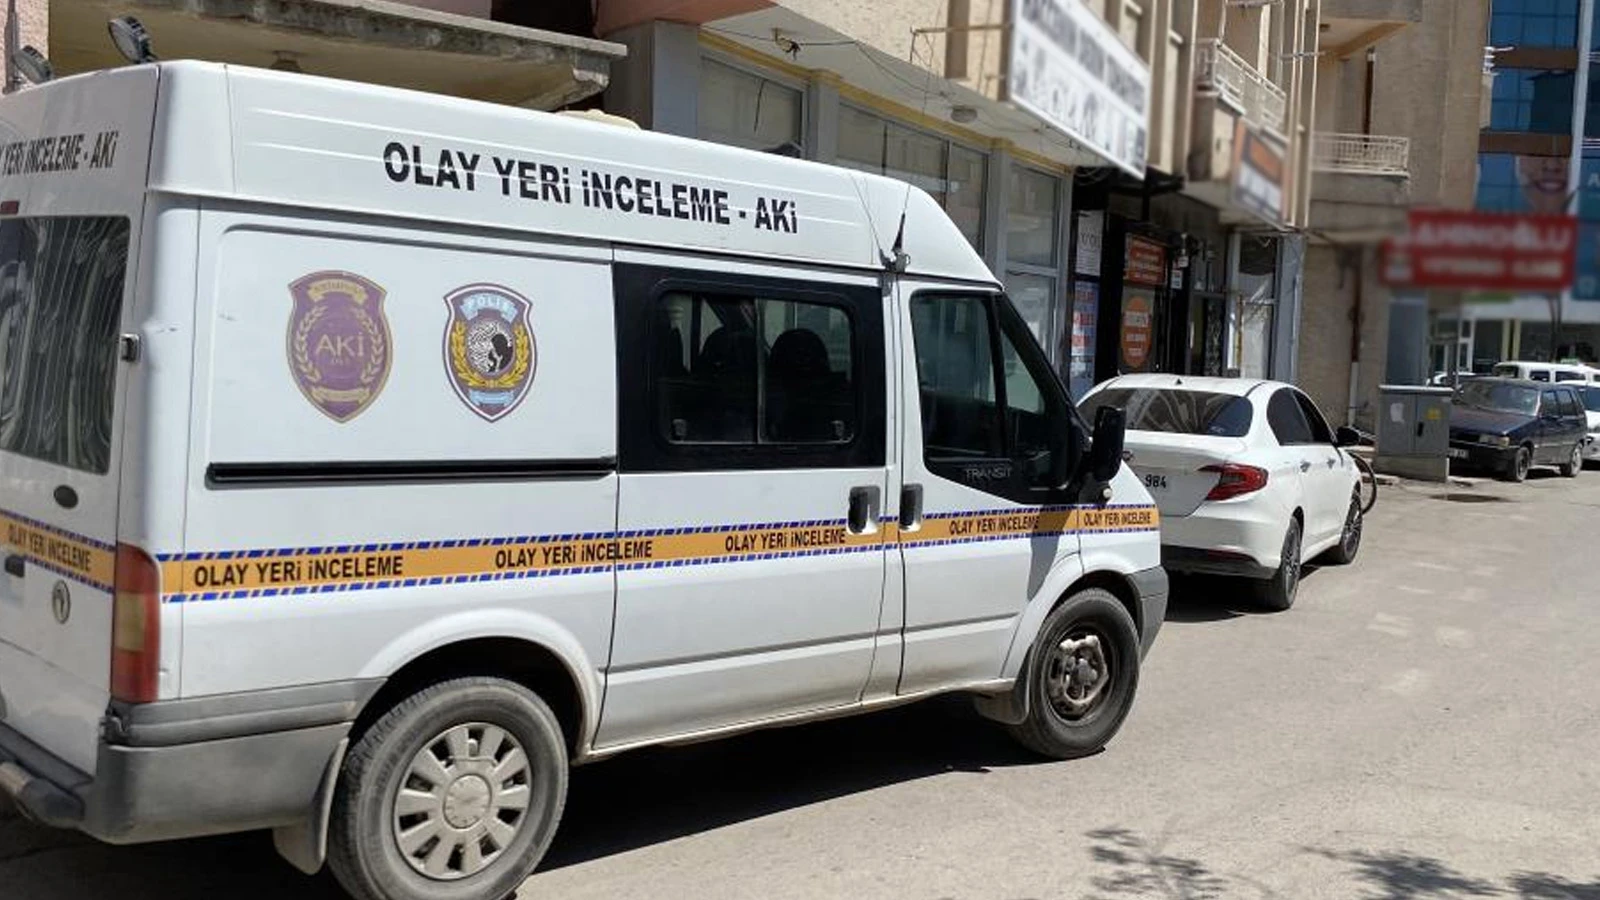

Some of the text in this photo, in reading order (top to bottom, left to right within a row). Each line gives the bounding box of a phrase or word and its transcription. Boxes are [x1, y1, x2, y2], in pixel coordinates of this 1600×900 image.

[383, 142, 480, 191] OLAY
[964, 467, 1012, 480] TRANSIT
[949, 519, 974, 535] OLAY
[1084, 512, 1103, 526] OLAY
[725, 533, 757, 552] OLAY
[495, 548, 538, 569] OLAY
[194, 564, 249, 587] OLAY
